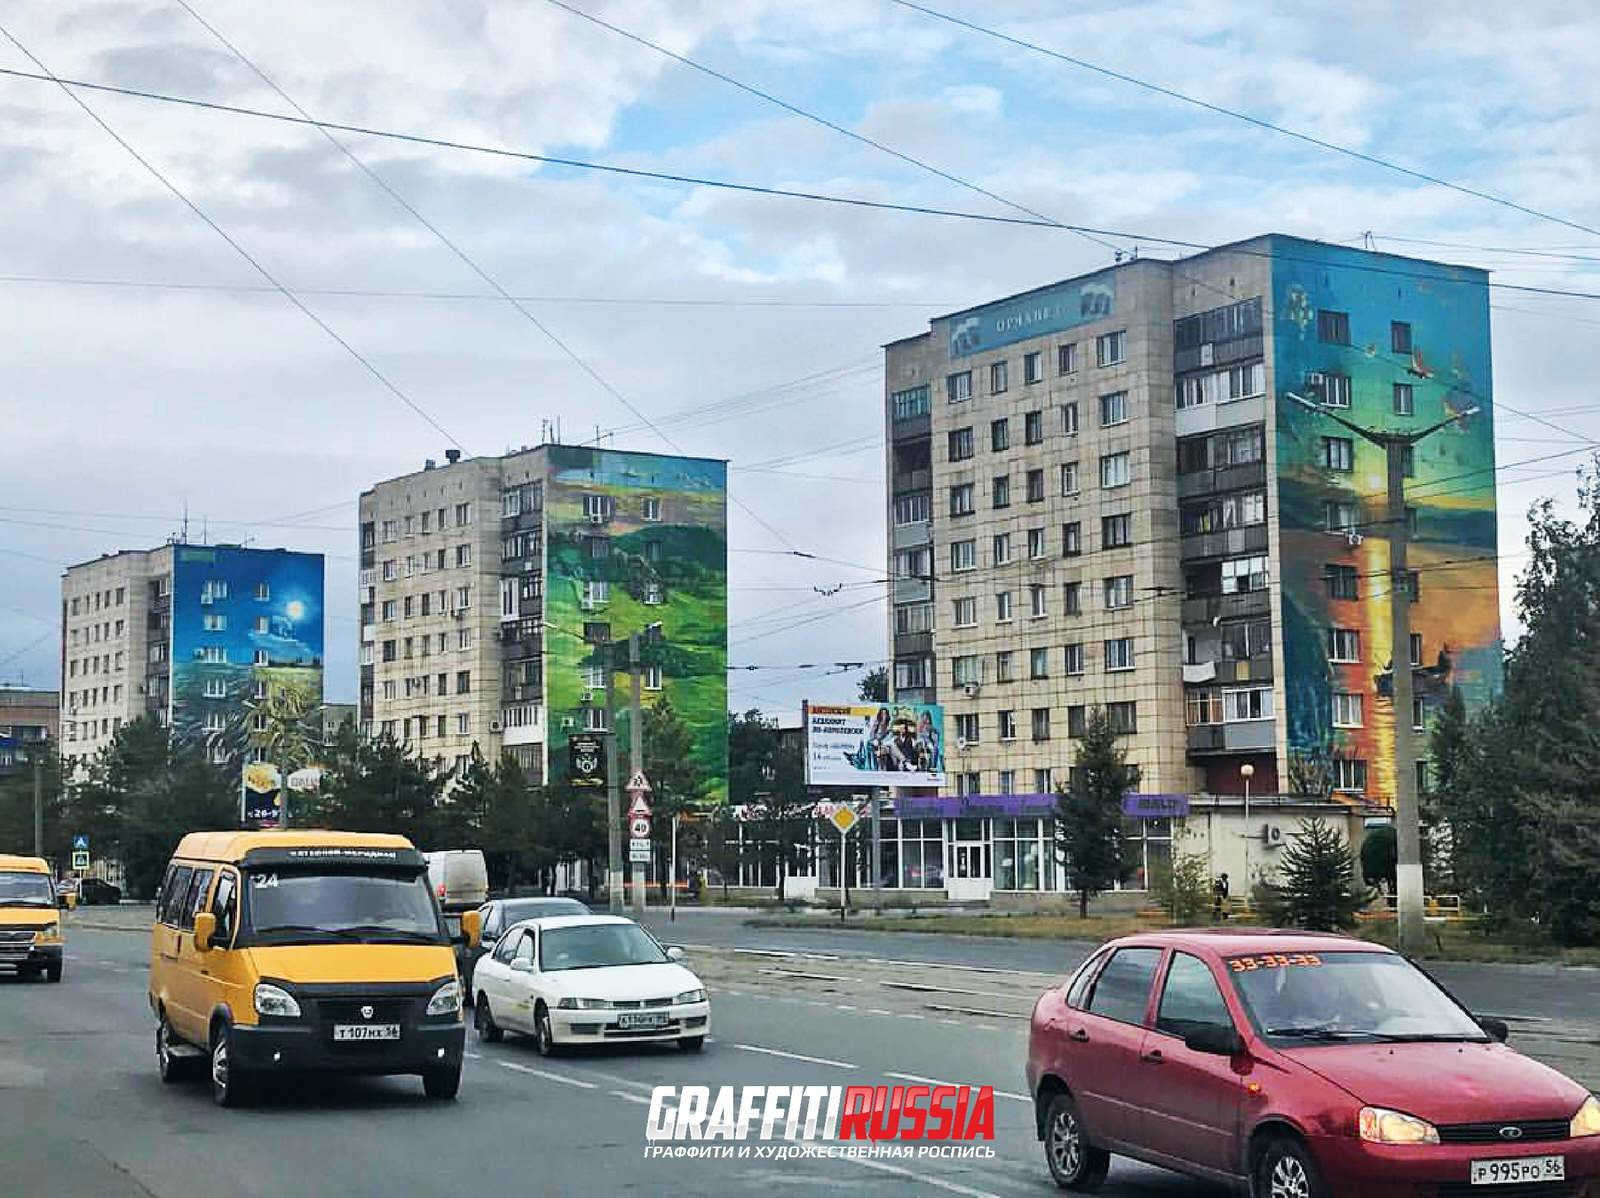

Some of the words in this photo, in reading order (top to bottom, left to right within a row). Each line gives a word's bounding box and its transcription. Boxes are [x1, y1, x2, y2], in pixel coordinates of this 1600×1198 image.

[634, 823, 647, 833] 40
[1228, 955, 1323, 973] 33-33-33
[1477, 1162, 1541, 1182] Р995РО
